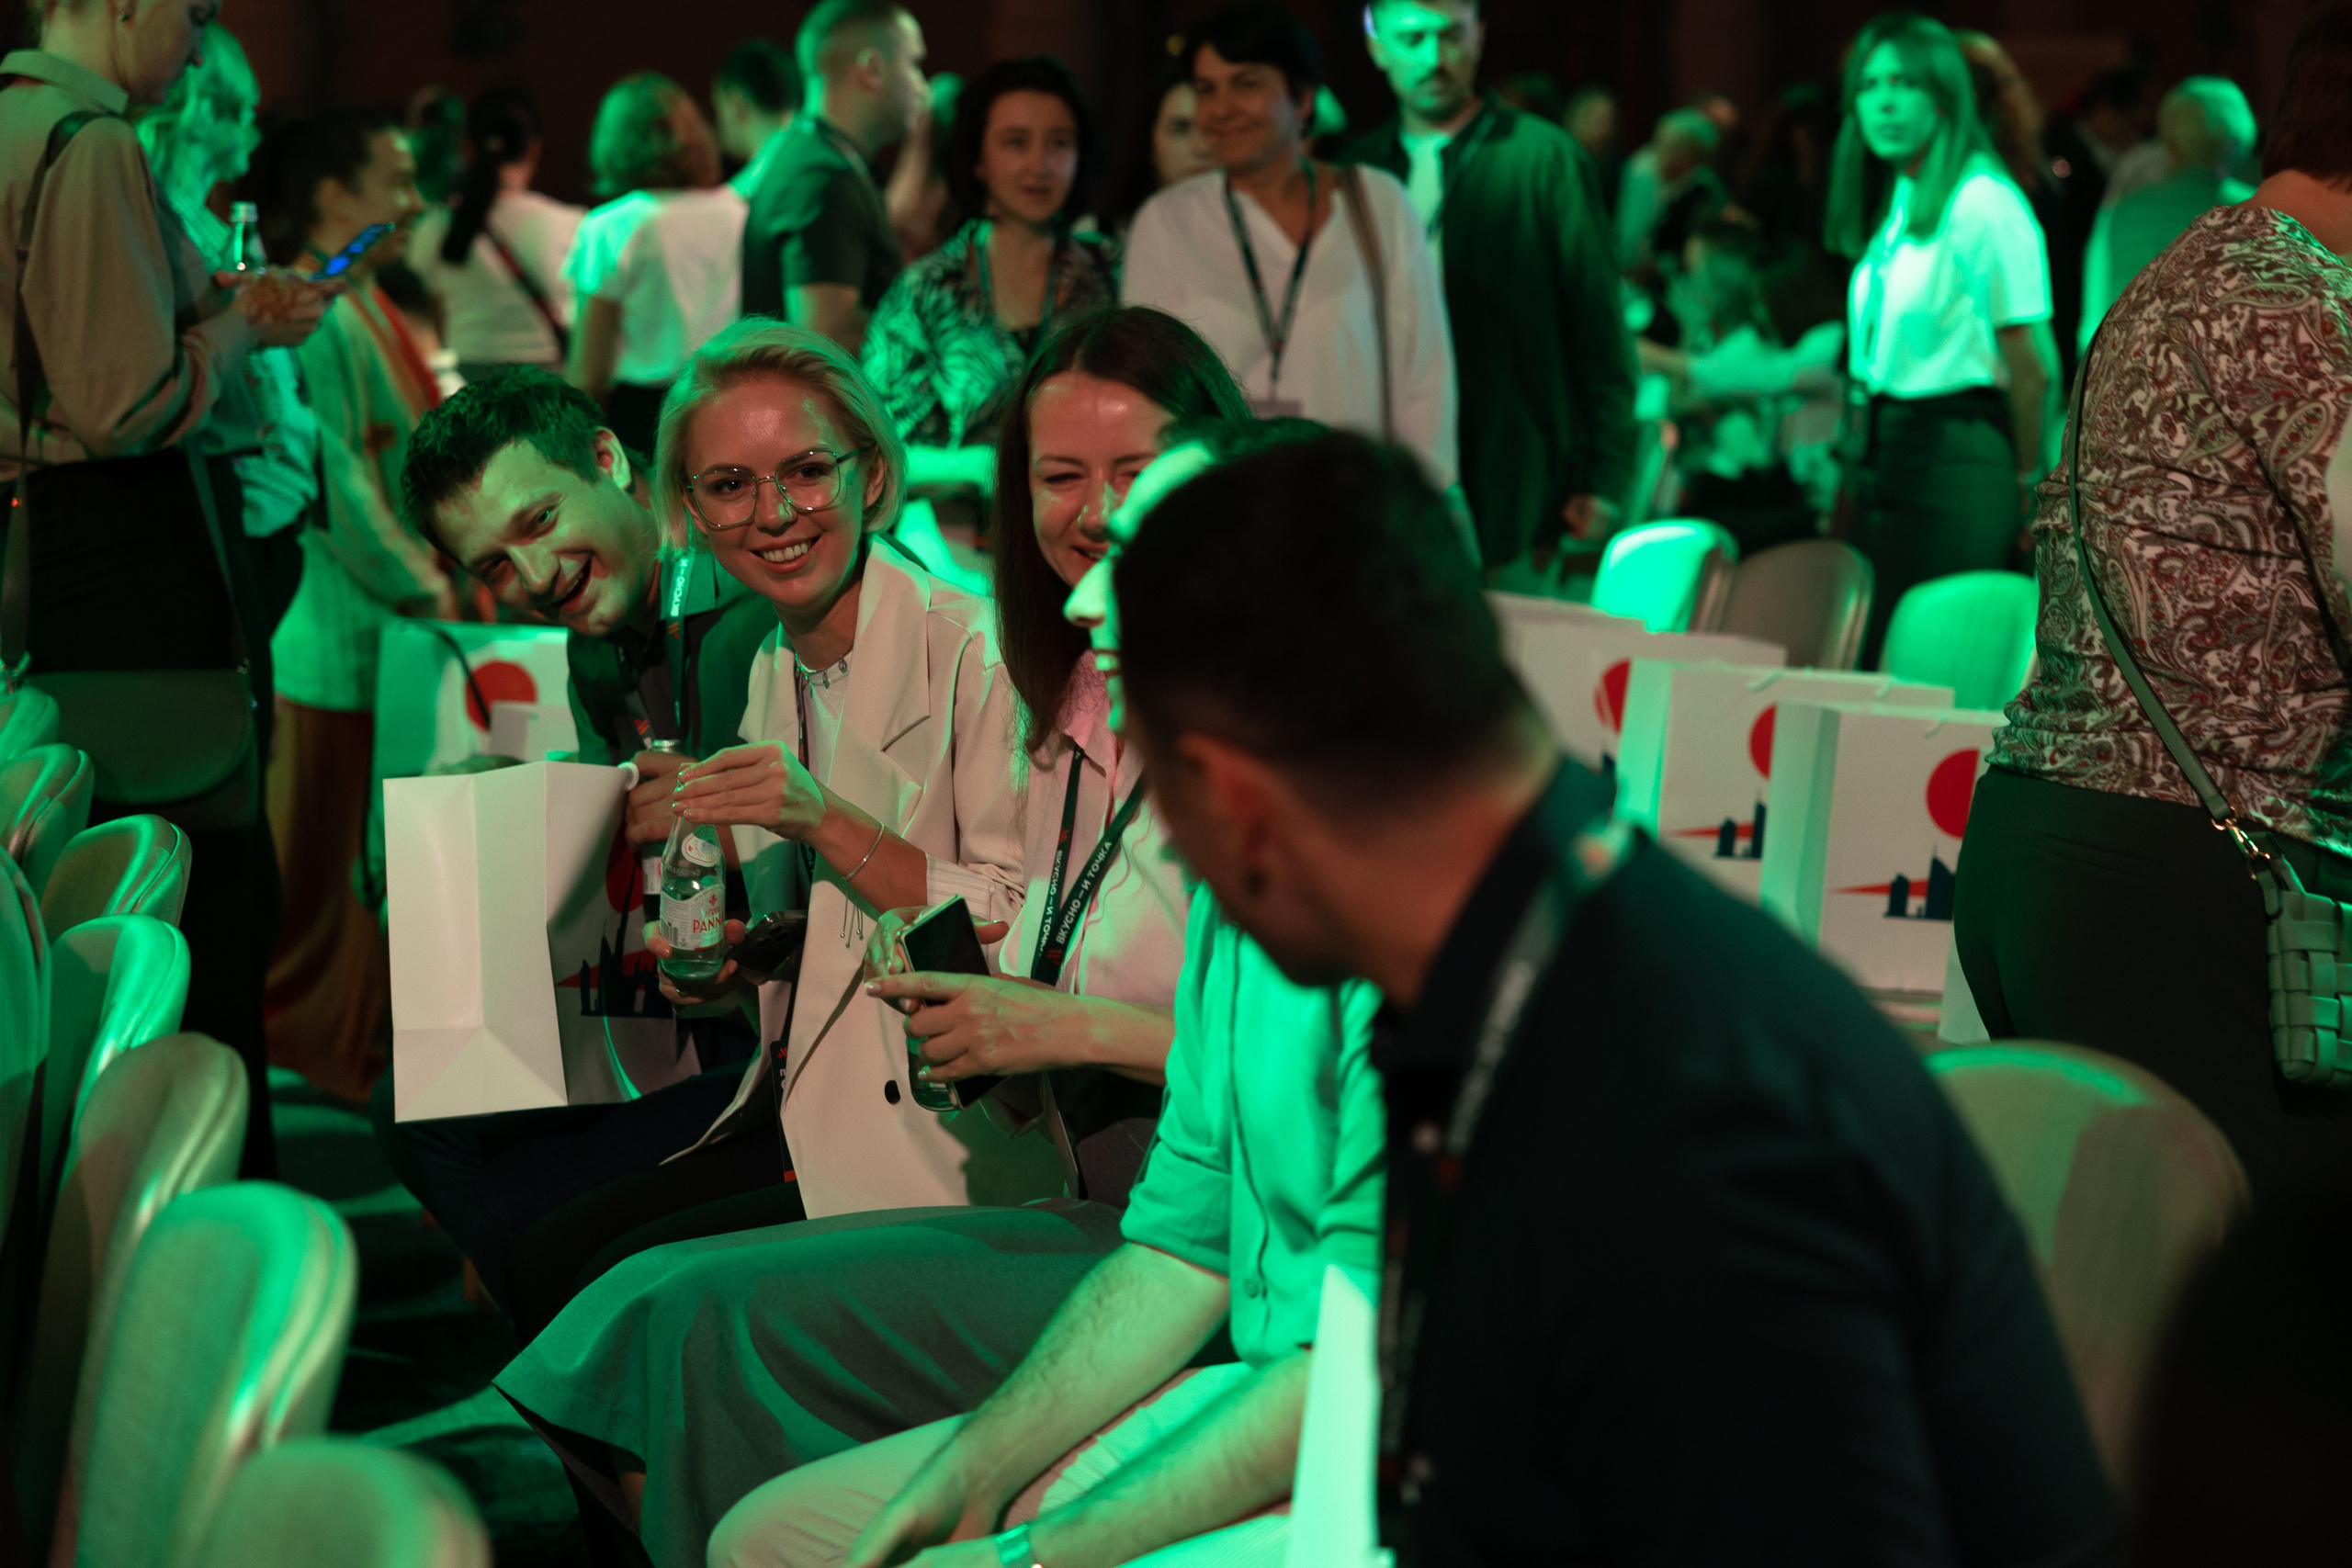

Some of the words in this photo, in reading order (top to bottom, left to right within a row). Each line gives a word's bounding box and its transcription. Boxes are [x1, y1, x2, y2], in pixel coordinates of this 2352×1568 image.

[671, 576, 685, 616] ВКУСНО
[679, 558, 688, 567] И
[1050, 850, 1063, 895] ВКУСНО
[1056, 899, 1081, 944] ВКУСНО
[1081, 879, 1091, 890] И
[1087, 841, 1113, 878] ТОЧКА
[1046, 907, 1054, 915] И
[1039, 917, 1052, 956] ТОЧ
